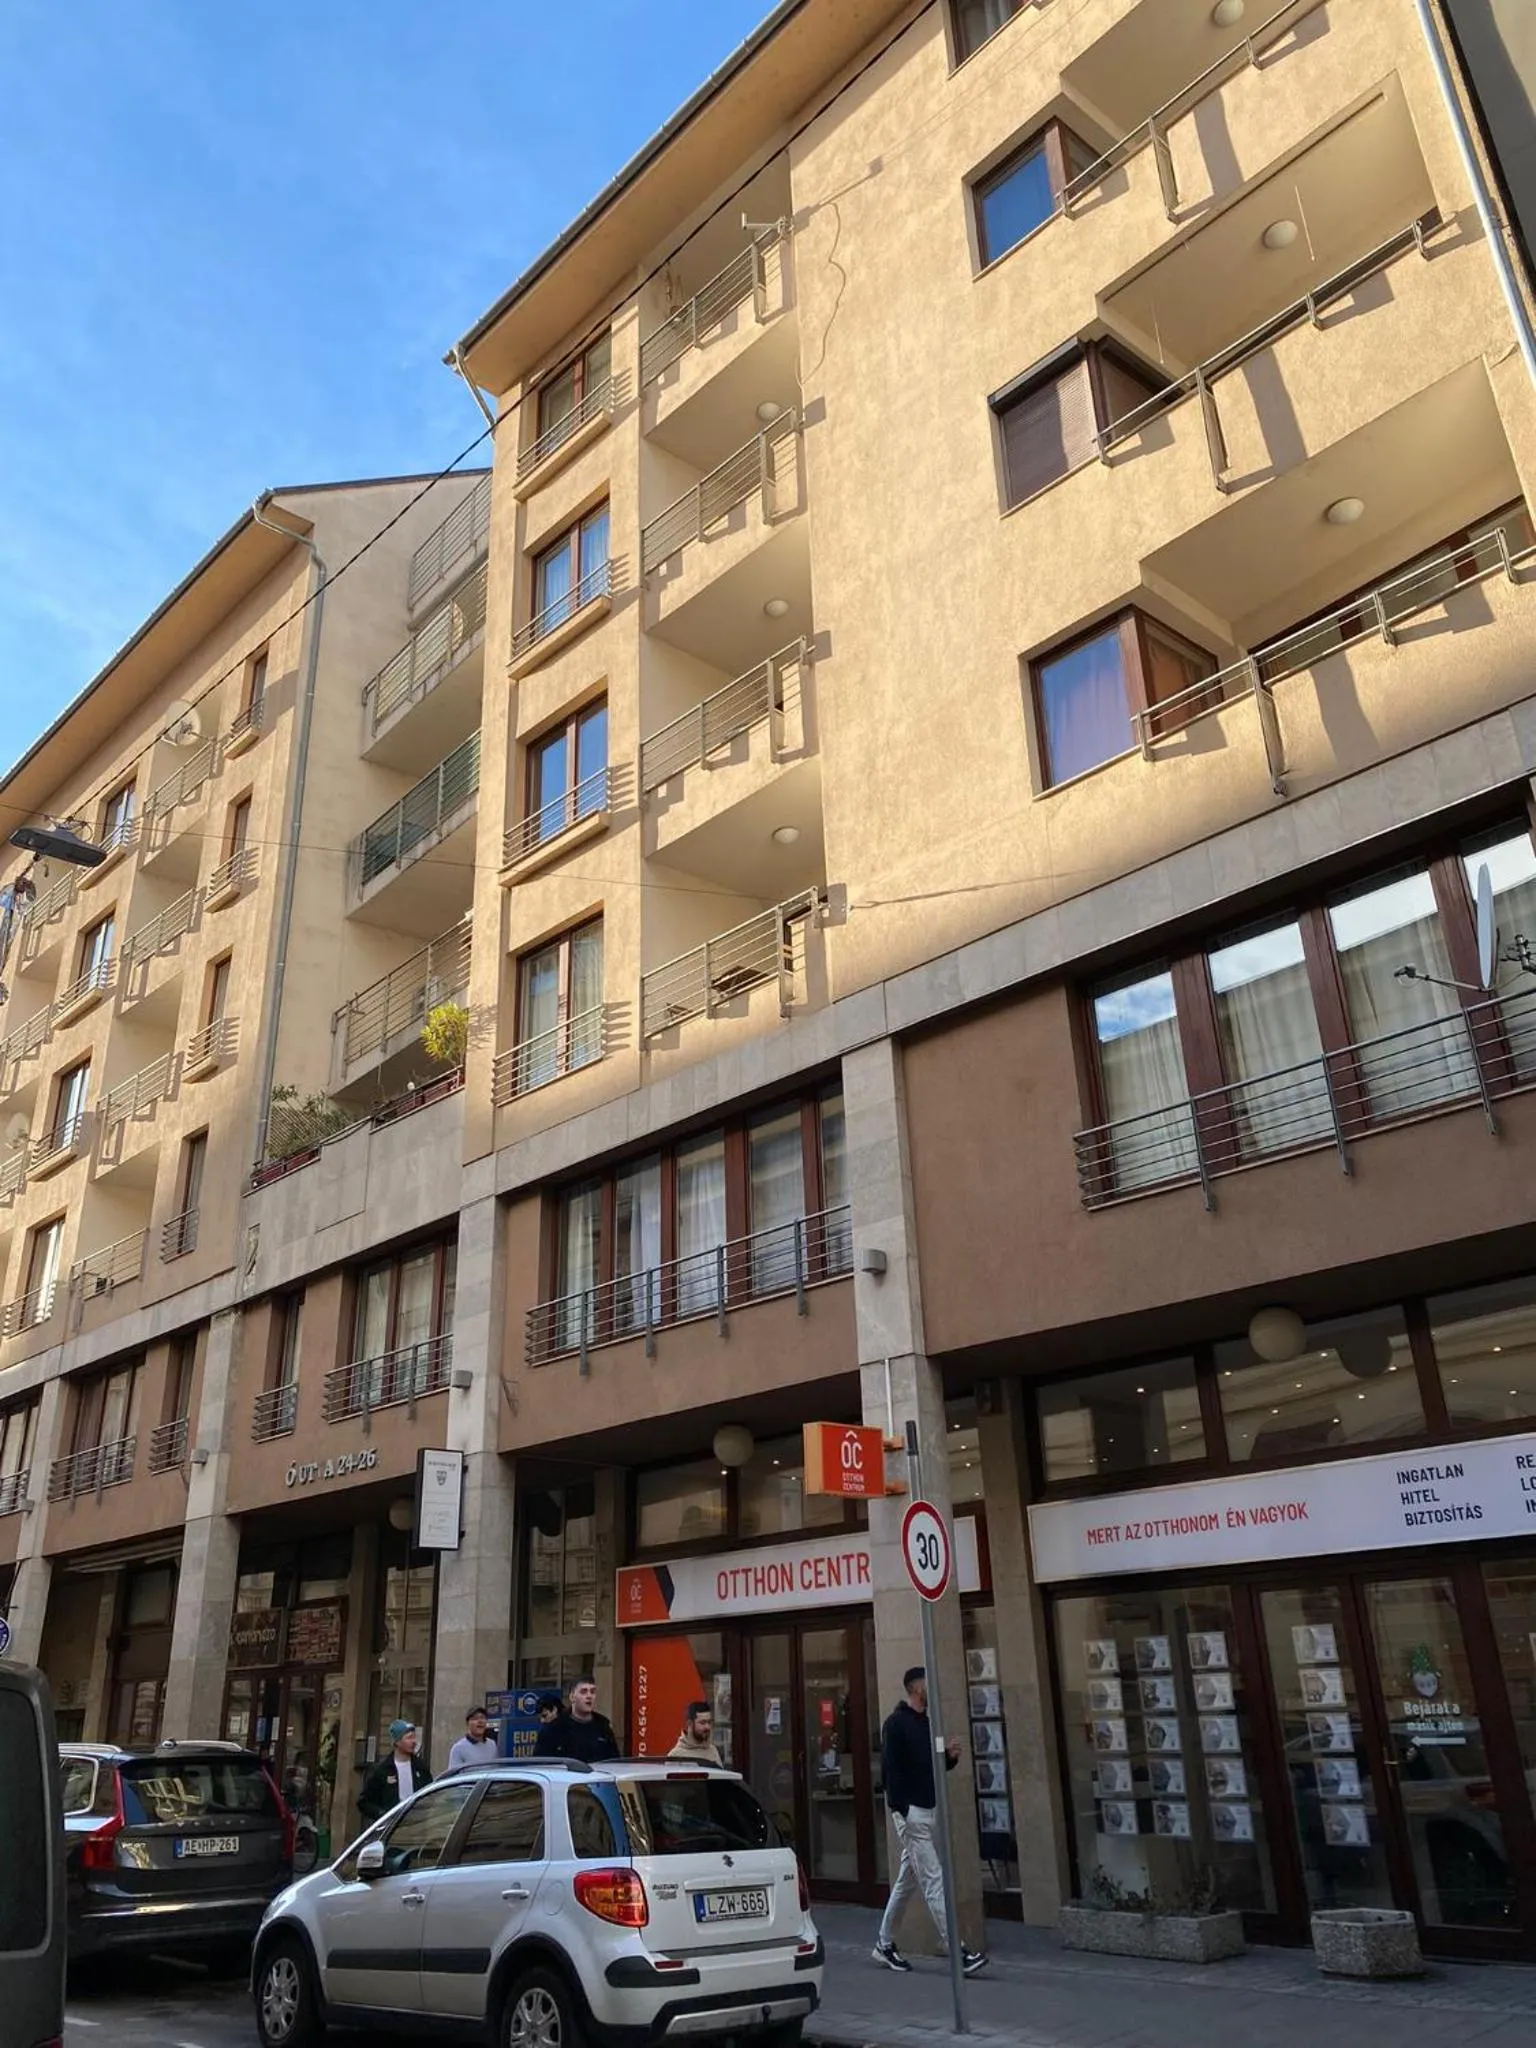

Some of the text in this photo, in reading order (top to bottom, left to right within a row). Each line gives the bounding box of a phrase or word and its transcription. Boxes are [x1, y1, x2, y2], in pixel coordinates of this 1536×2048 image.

[337, 1447, 377, 1475] 24-26
[1396, 1463, 1464, 1485] INGATLAN
[1400, 1488, 1440, 1505] HITEL
[1087, 1502, 1309, 1546] MERT AZ OTTHONOM ÉN VAGYOK
[1404, 1502, 1484, 1526] BIZTOSÍTÁS
[916, 1532, 939, 1571] 30
[717, 1552, 870, 1600] OTTHON CENTR
[639, 1665, 647, 1700] 1227
[639, 1706, 647, 1737] 454
[707, 1892, 764, 1915] LZW-665
